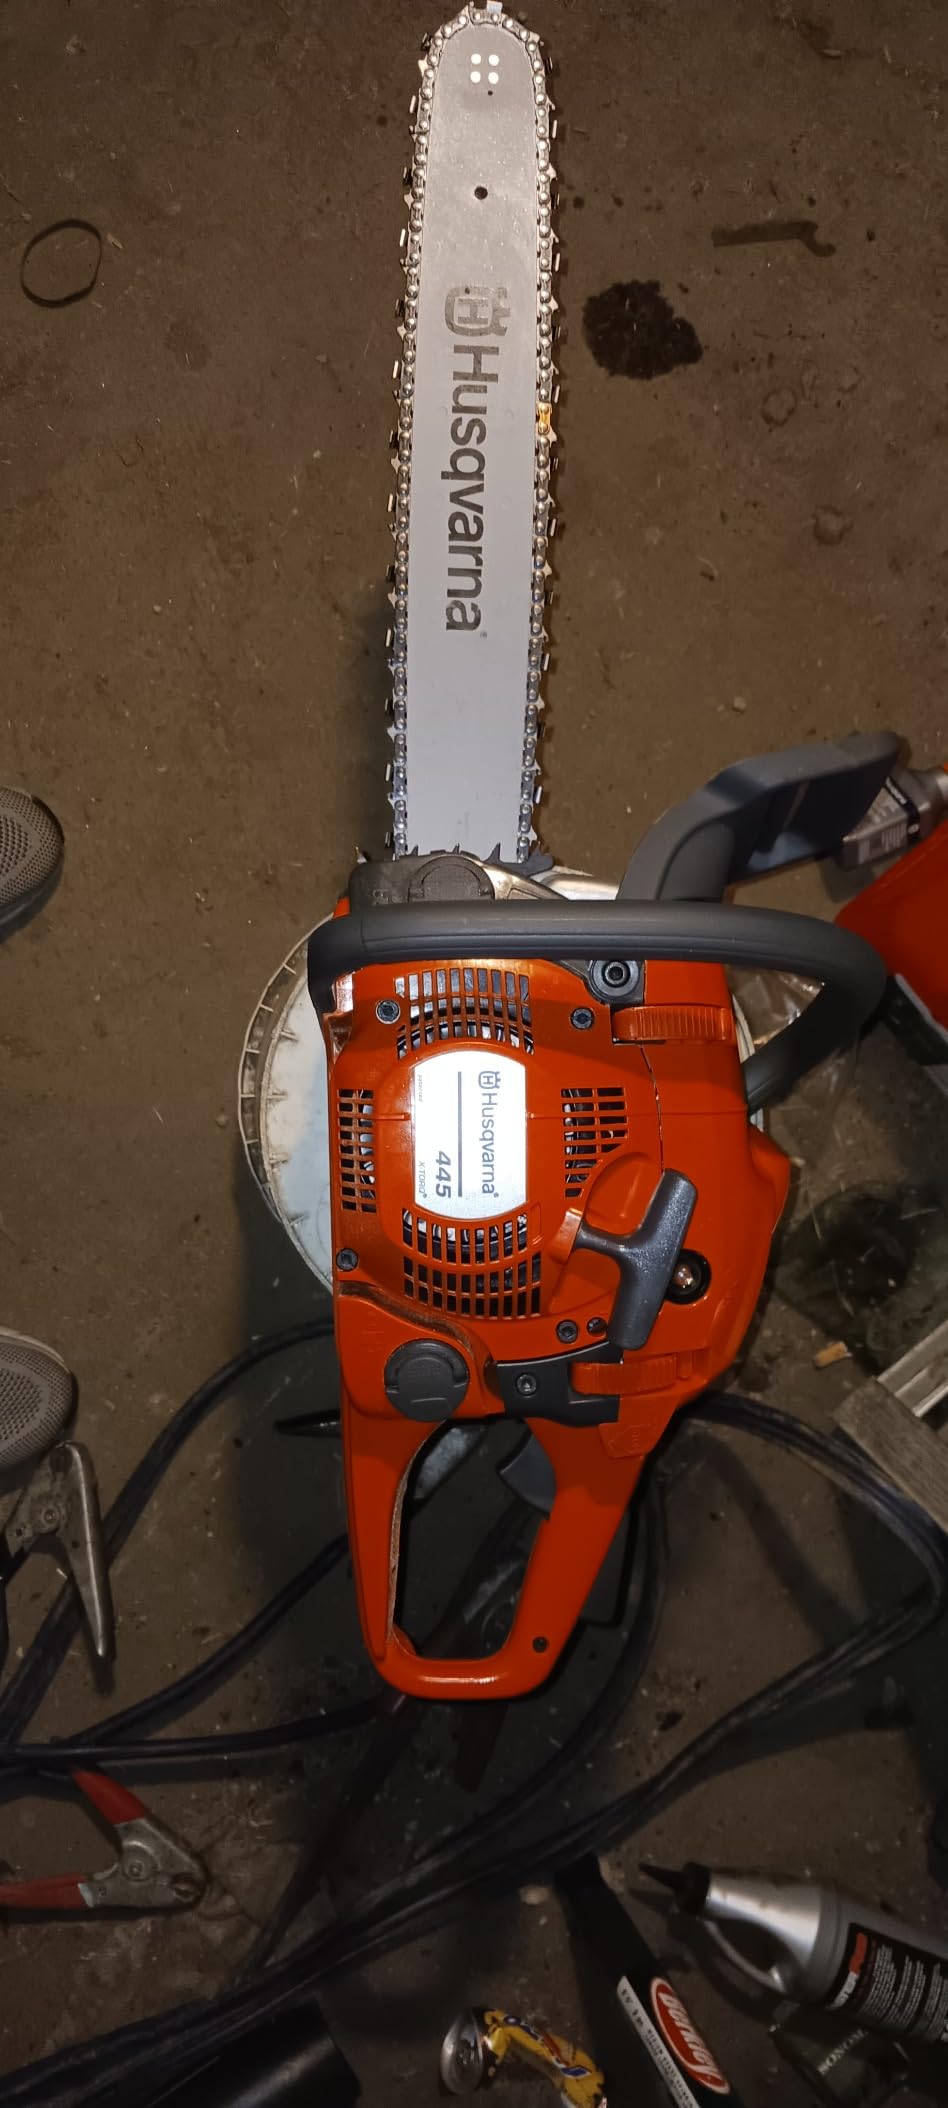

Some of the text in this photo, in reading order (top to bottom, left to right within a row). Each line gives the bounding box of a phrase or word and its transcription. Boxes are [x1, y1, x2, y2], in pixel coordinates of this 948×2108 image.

[441, 344, 500, 631] Husqvarna
[435, 1150, 452, 1198] 445
[479, 1092, 498, 1194] Husqvarna
